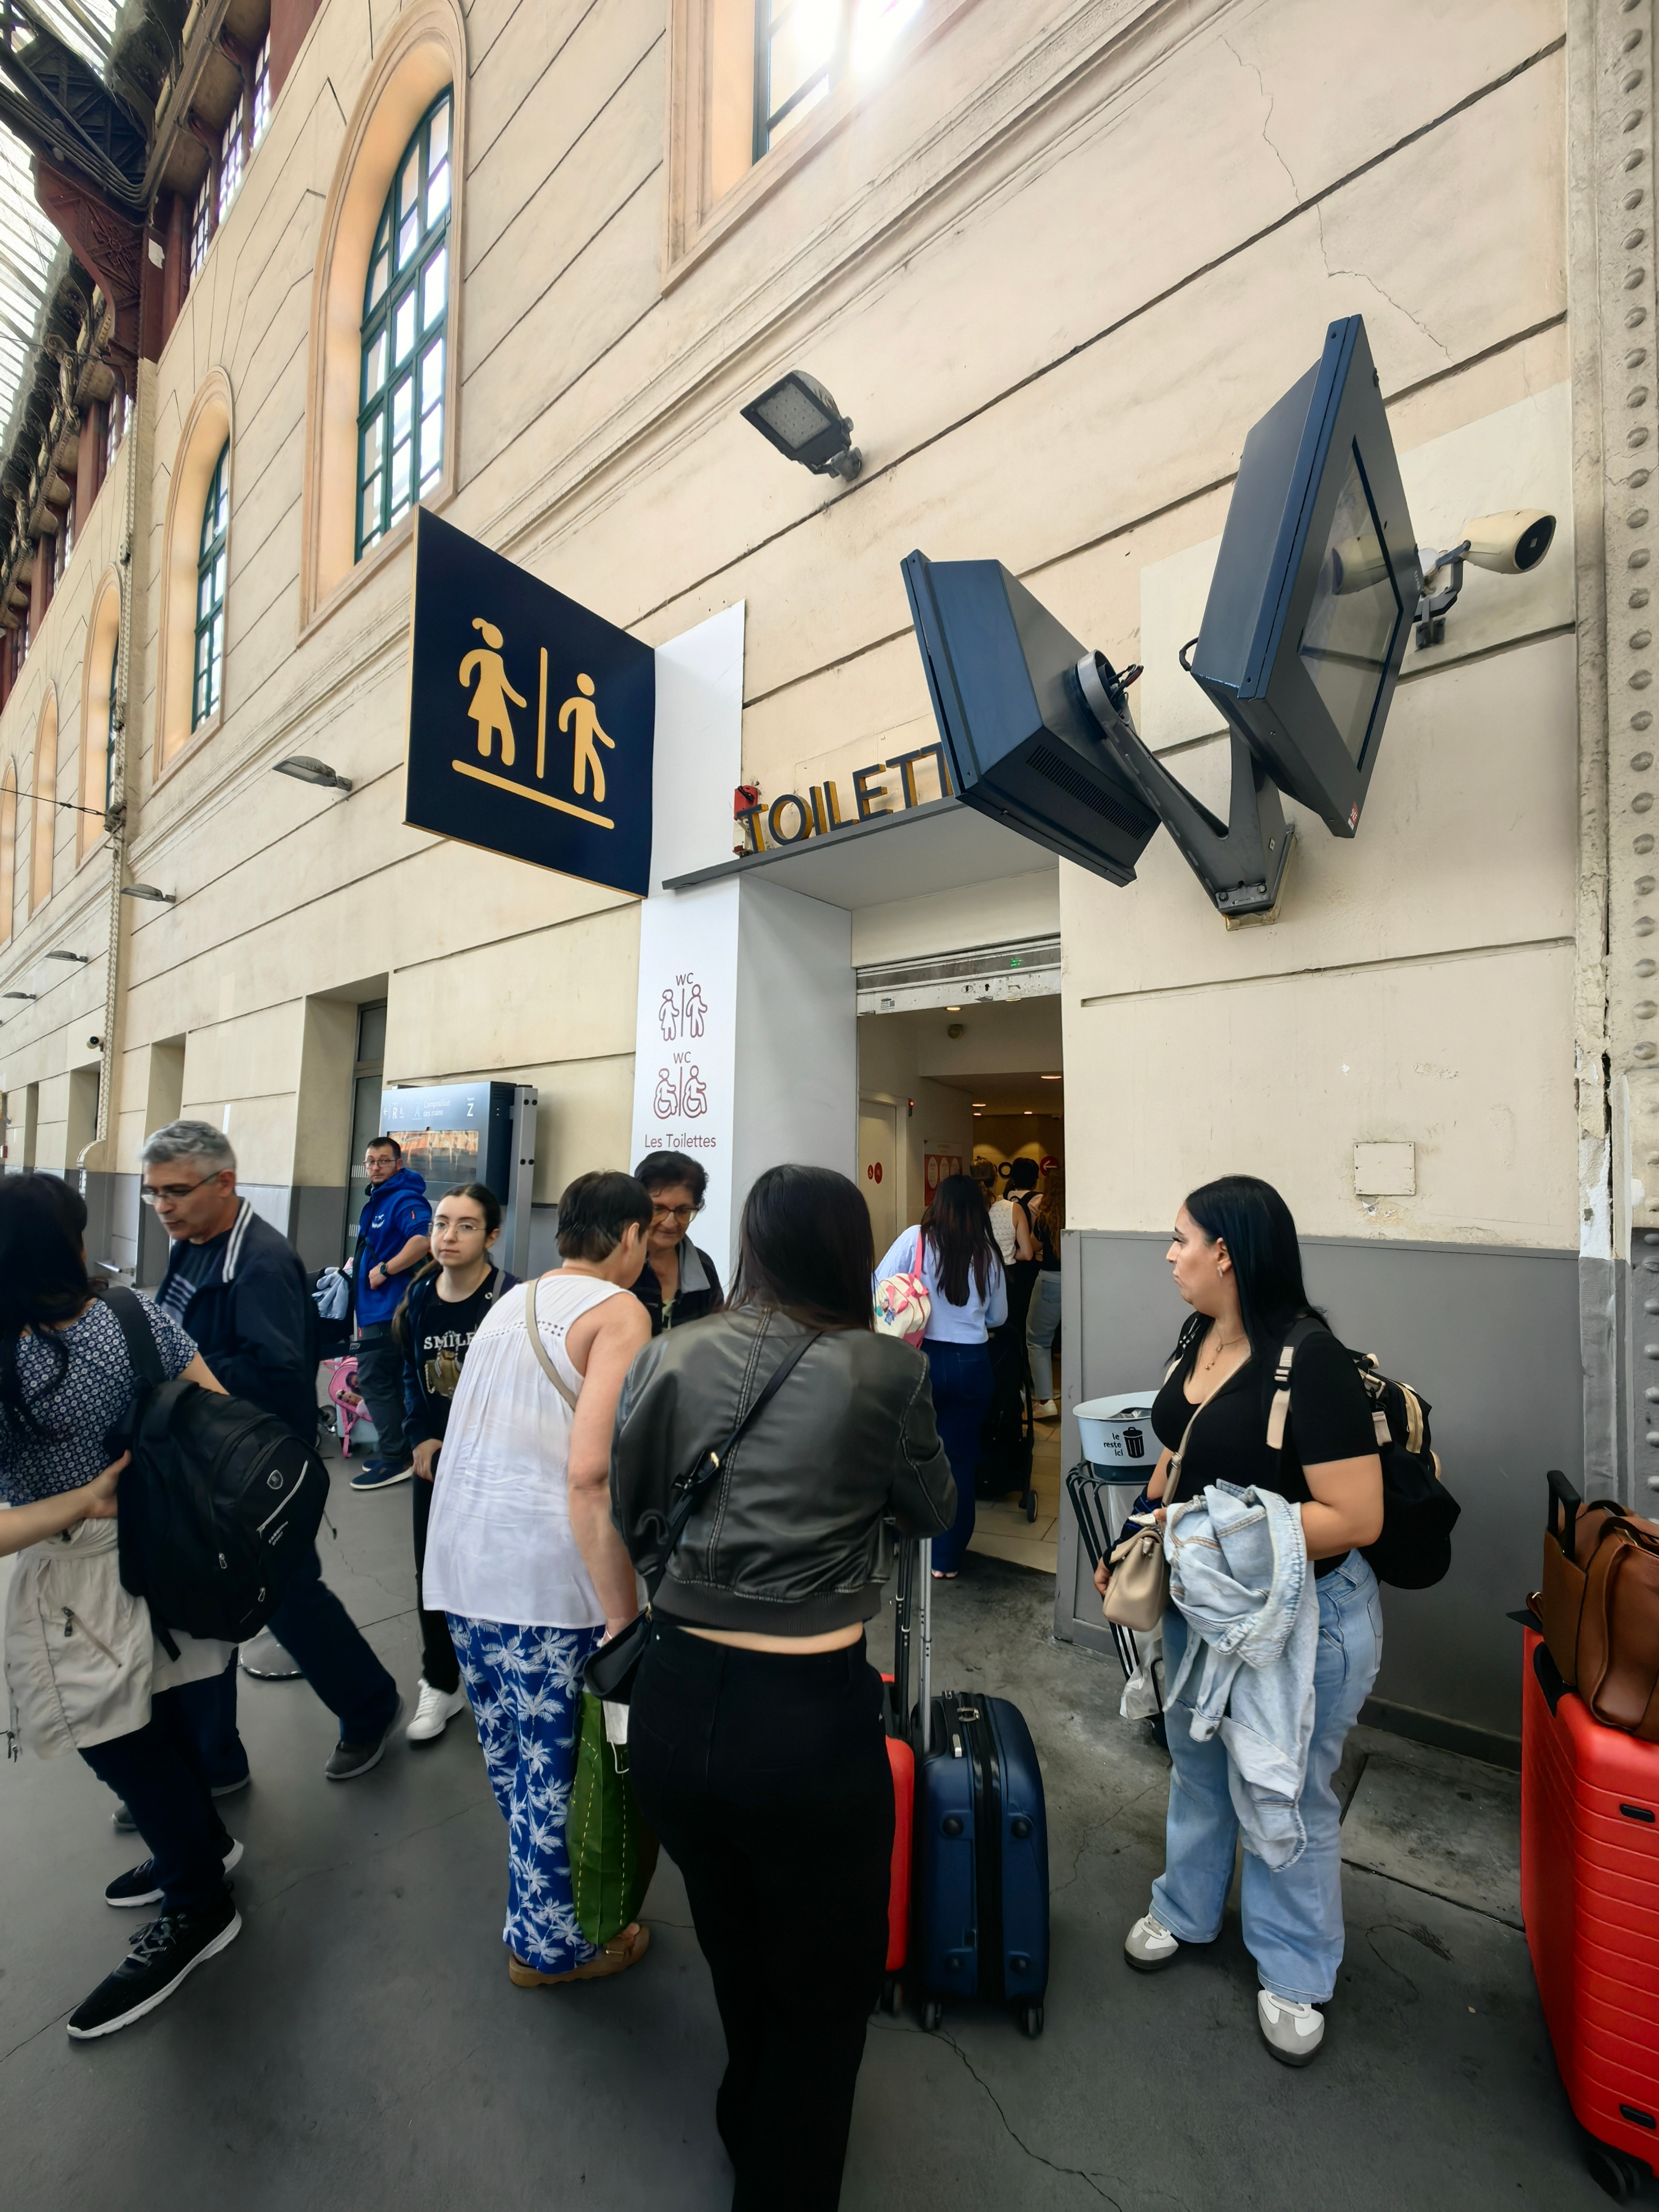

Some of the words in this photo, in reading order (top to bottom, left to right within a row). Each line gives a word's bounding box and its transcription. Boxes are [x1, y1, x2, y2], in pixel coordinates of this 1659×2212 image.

[675, 973, 694, 986] WC
[673, 1051, 691, 1064] WC
[392, 1107, 398, 1119] R
[467, 1103, 474, 1117] Z
[645, 1134, 663, 1147] Les
[666, 1133, 716, 1148] Toilettes
